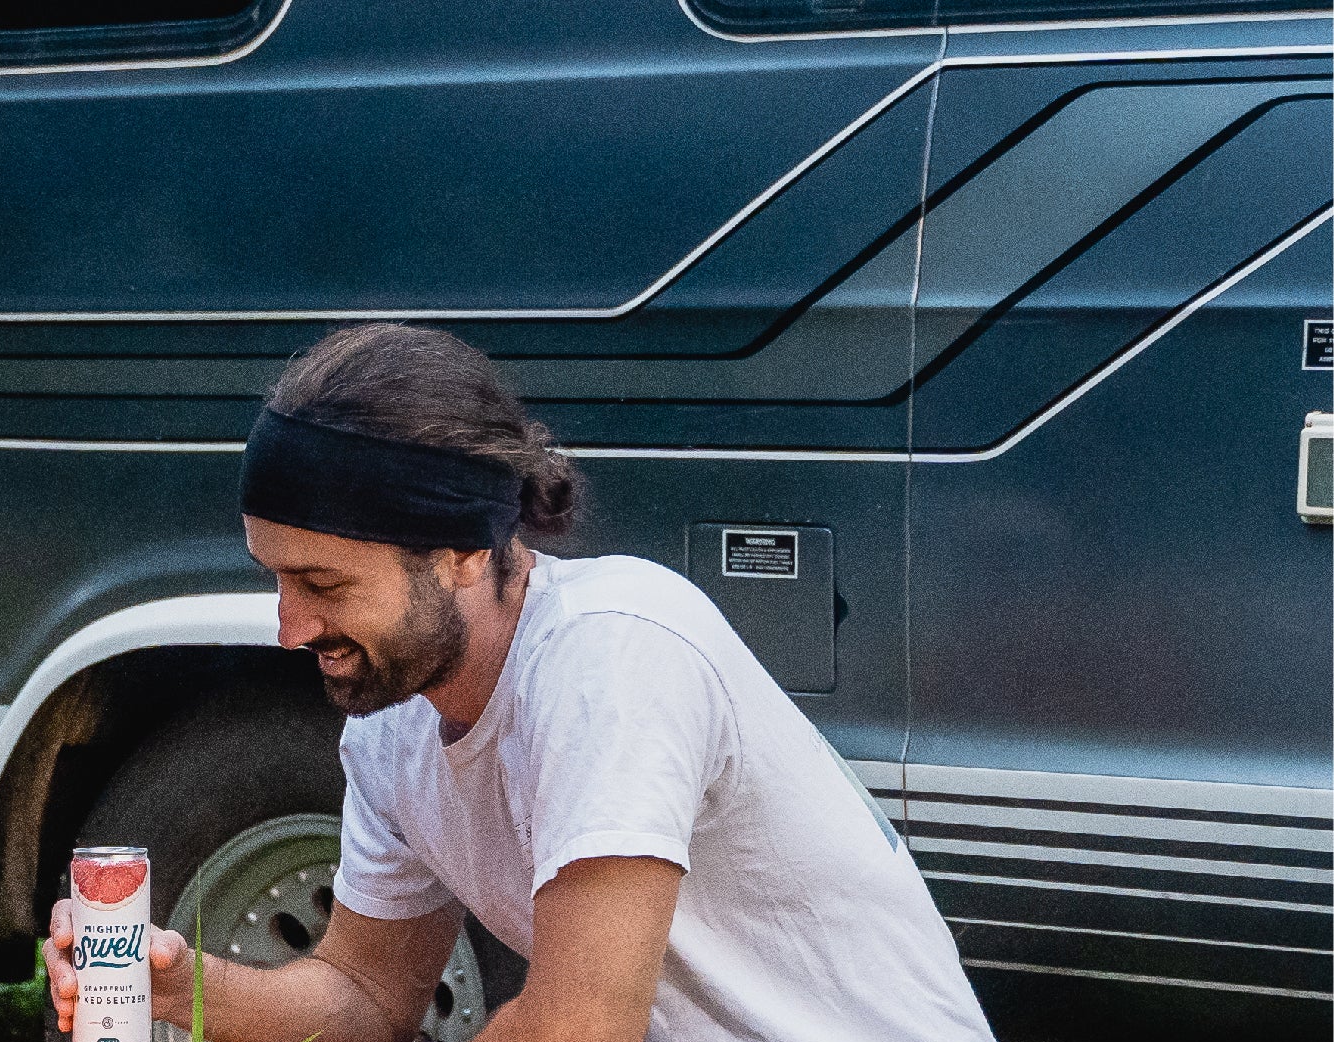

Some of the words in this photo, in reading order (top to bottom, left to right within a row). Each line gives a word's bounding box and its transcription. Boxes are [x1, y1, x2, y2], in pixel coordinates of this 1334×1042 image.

[84, 925, 128, 934] MIGHTY
[72, 923, 145, 971] Swell
[83, 984, 133, 992] GRAPEFRUIT
[106, 994, 146, 1005] SELTZER
